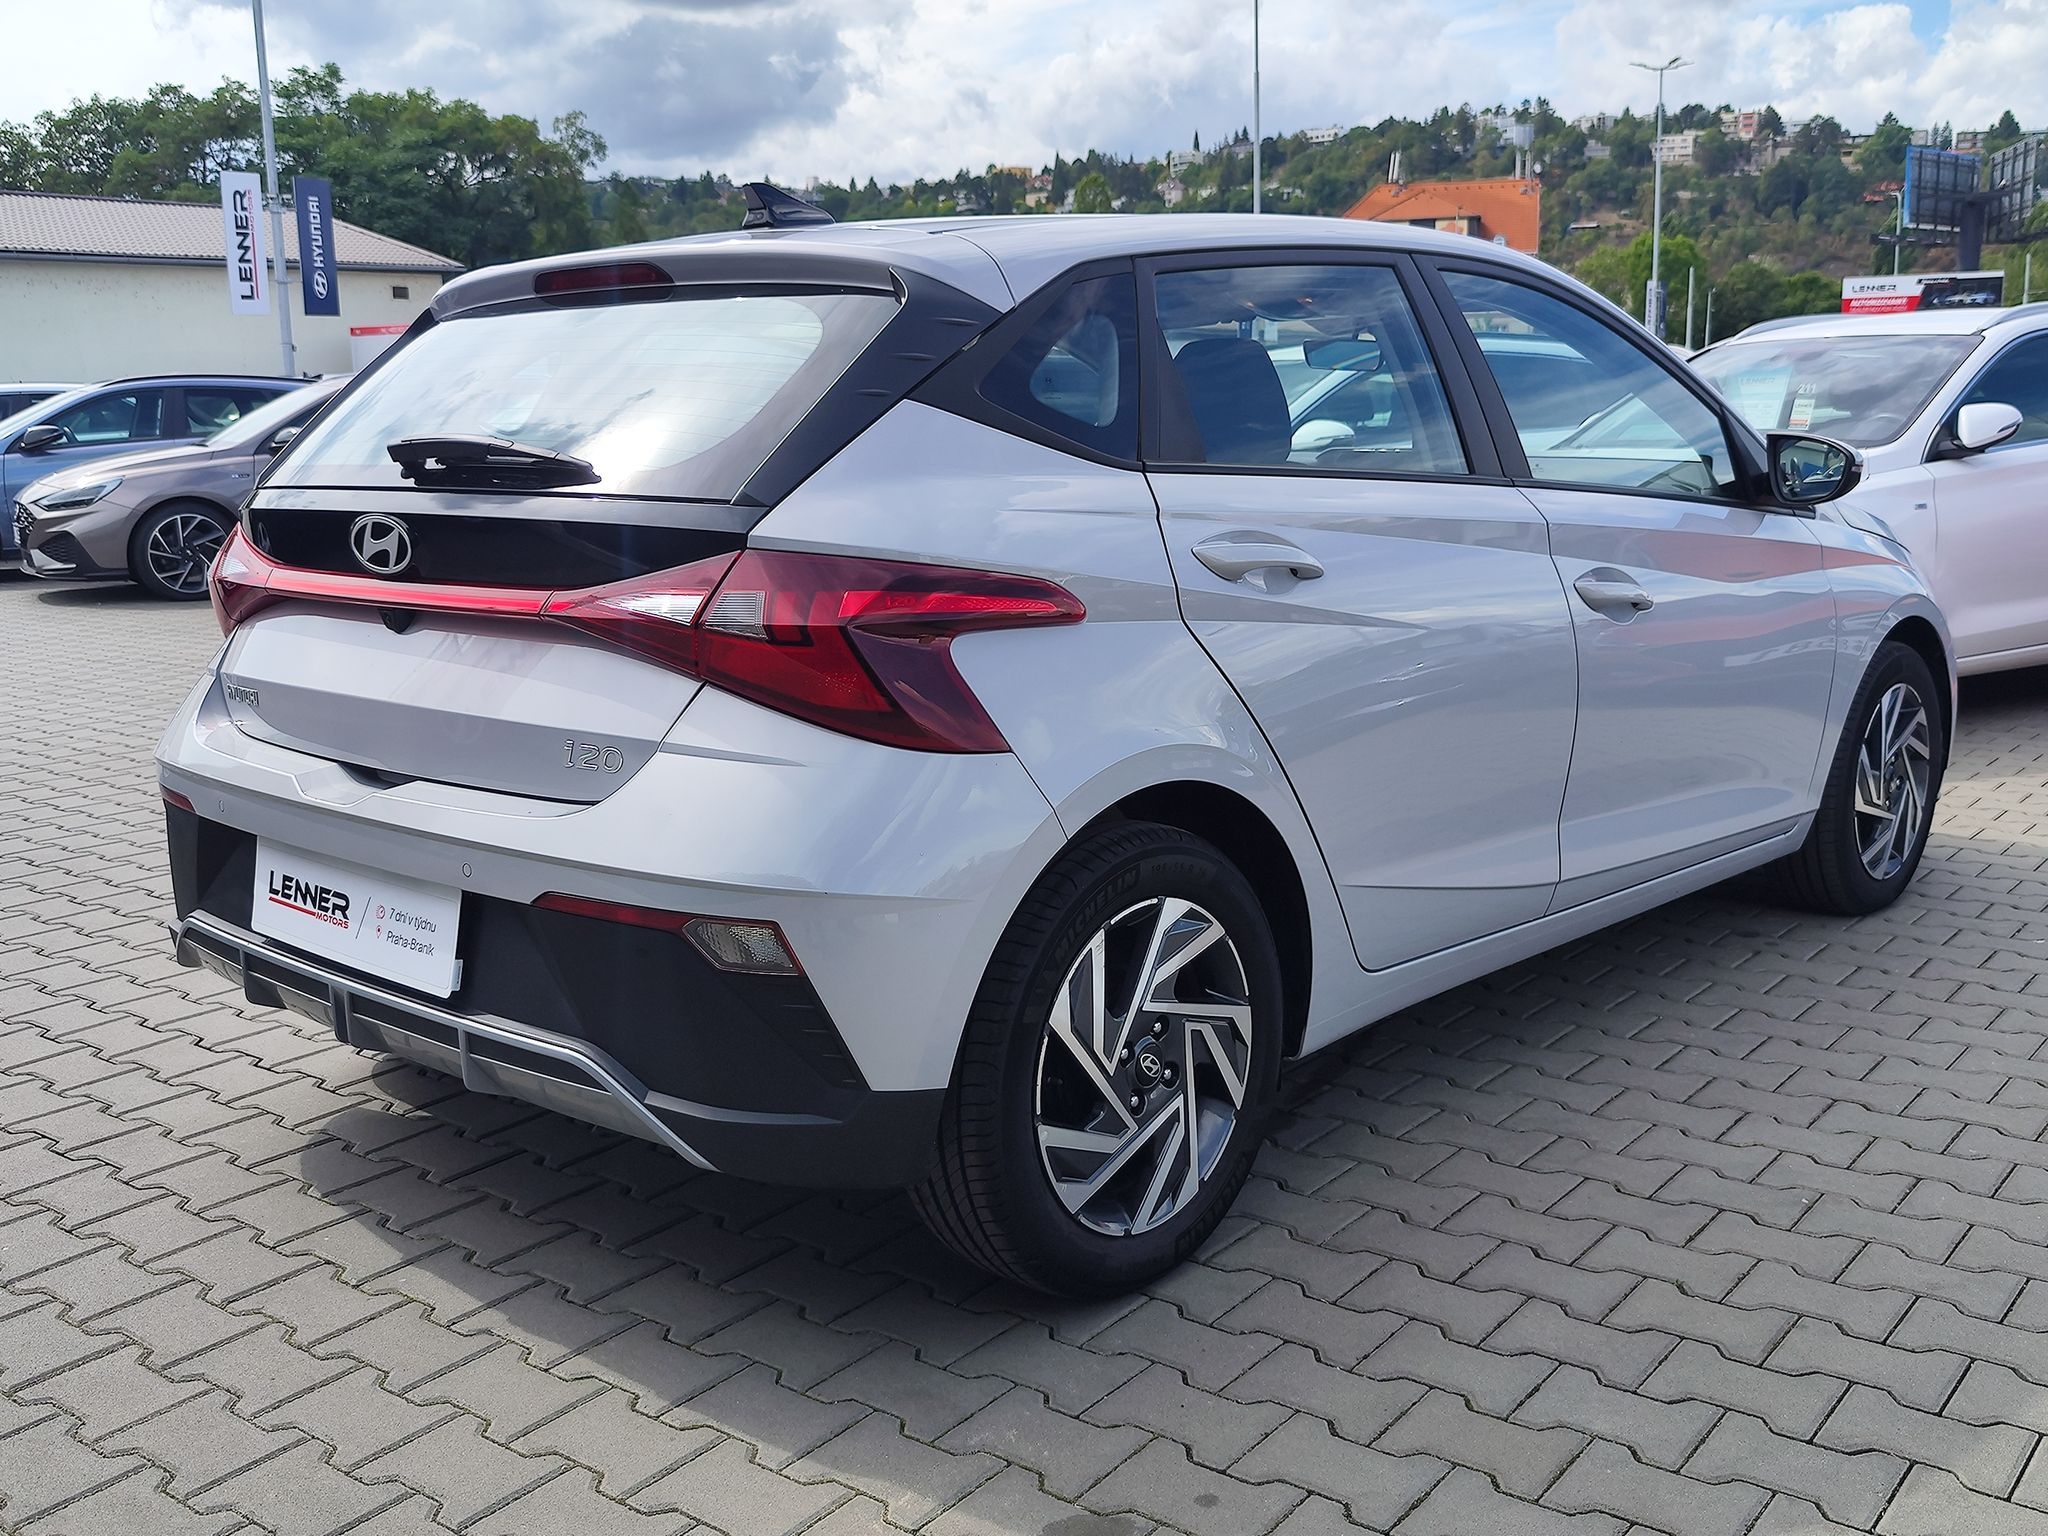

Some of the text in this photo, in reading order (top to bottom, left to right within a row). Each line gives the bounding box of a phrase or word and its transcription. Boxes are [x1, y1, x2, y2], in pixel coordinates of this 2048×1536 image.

[233, 190, 255, 300] LENNER
[308, 196, 325, 268] HYUNDAI
[268, 870, 350, 920] LENNER
[315, 911, 349, 929] MOTORS
[389, 908, 395, 920] 7
[414, 916, 437, 933] týdnu
